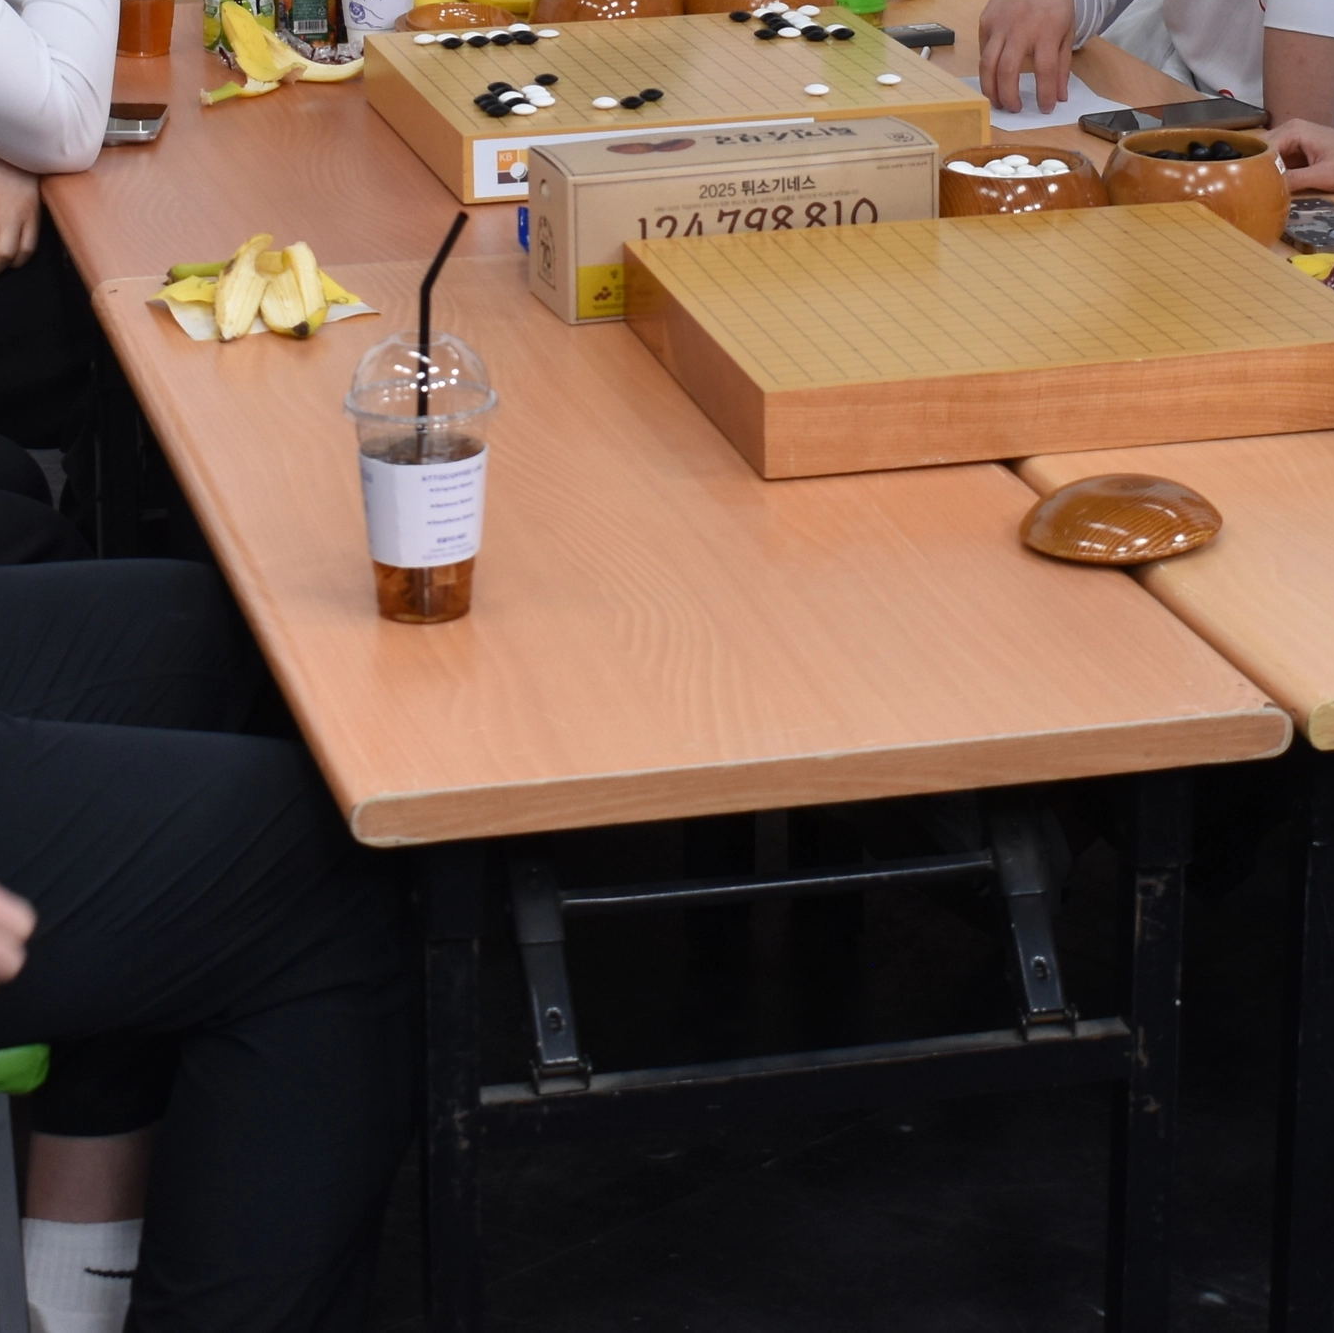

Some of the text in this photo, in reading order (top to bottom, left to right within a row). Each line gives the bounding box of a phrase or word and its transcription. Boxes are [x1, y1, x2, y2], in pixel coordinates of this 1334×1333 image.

[498, 151, 514, 163] KB
[698, 182, 737, 200] 2025
[740, 175, 816, 197] 튀소기네스
